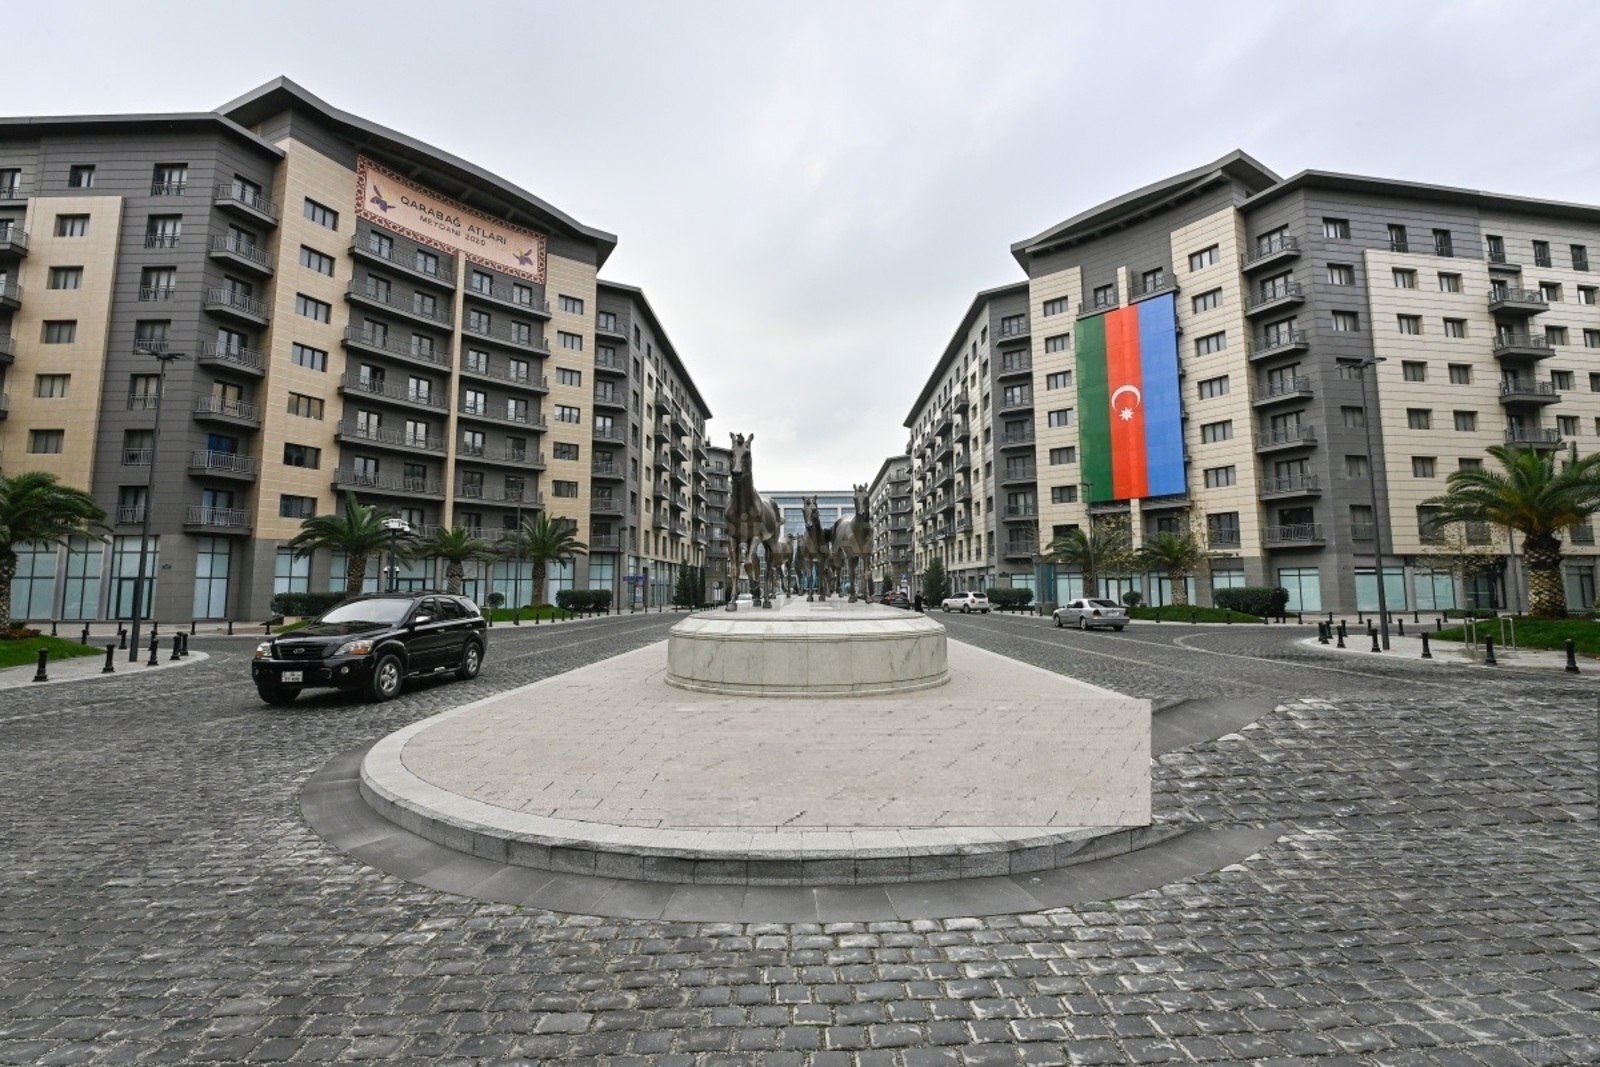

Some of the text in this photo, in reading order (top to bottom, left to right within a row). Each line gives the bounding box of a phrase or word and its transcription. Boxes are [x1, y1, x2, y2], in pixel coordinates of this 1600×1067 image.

[400, 195, 507, 245] QARABAĞ ATLARI
[465, 234, 486, 247] 2020
